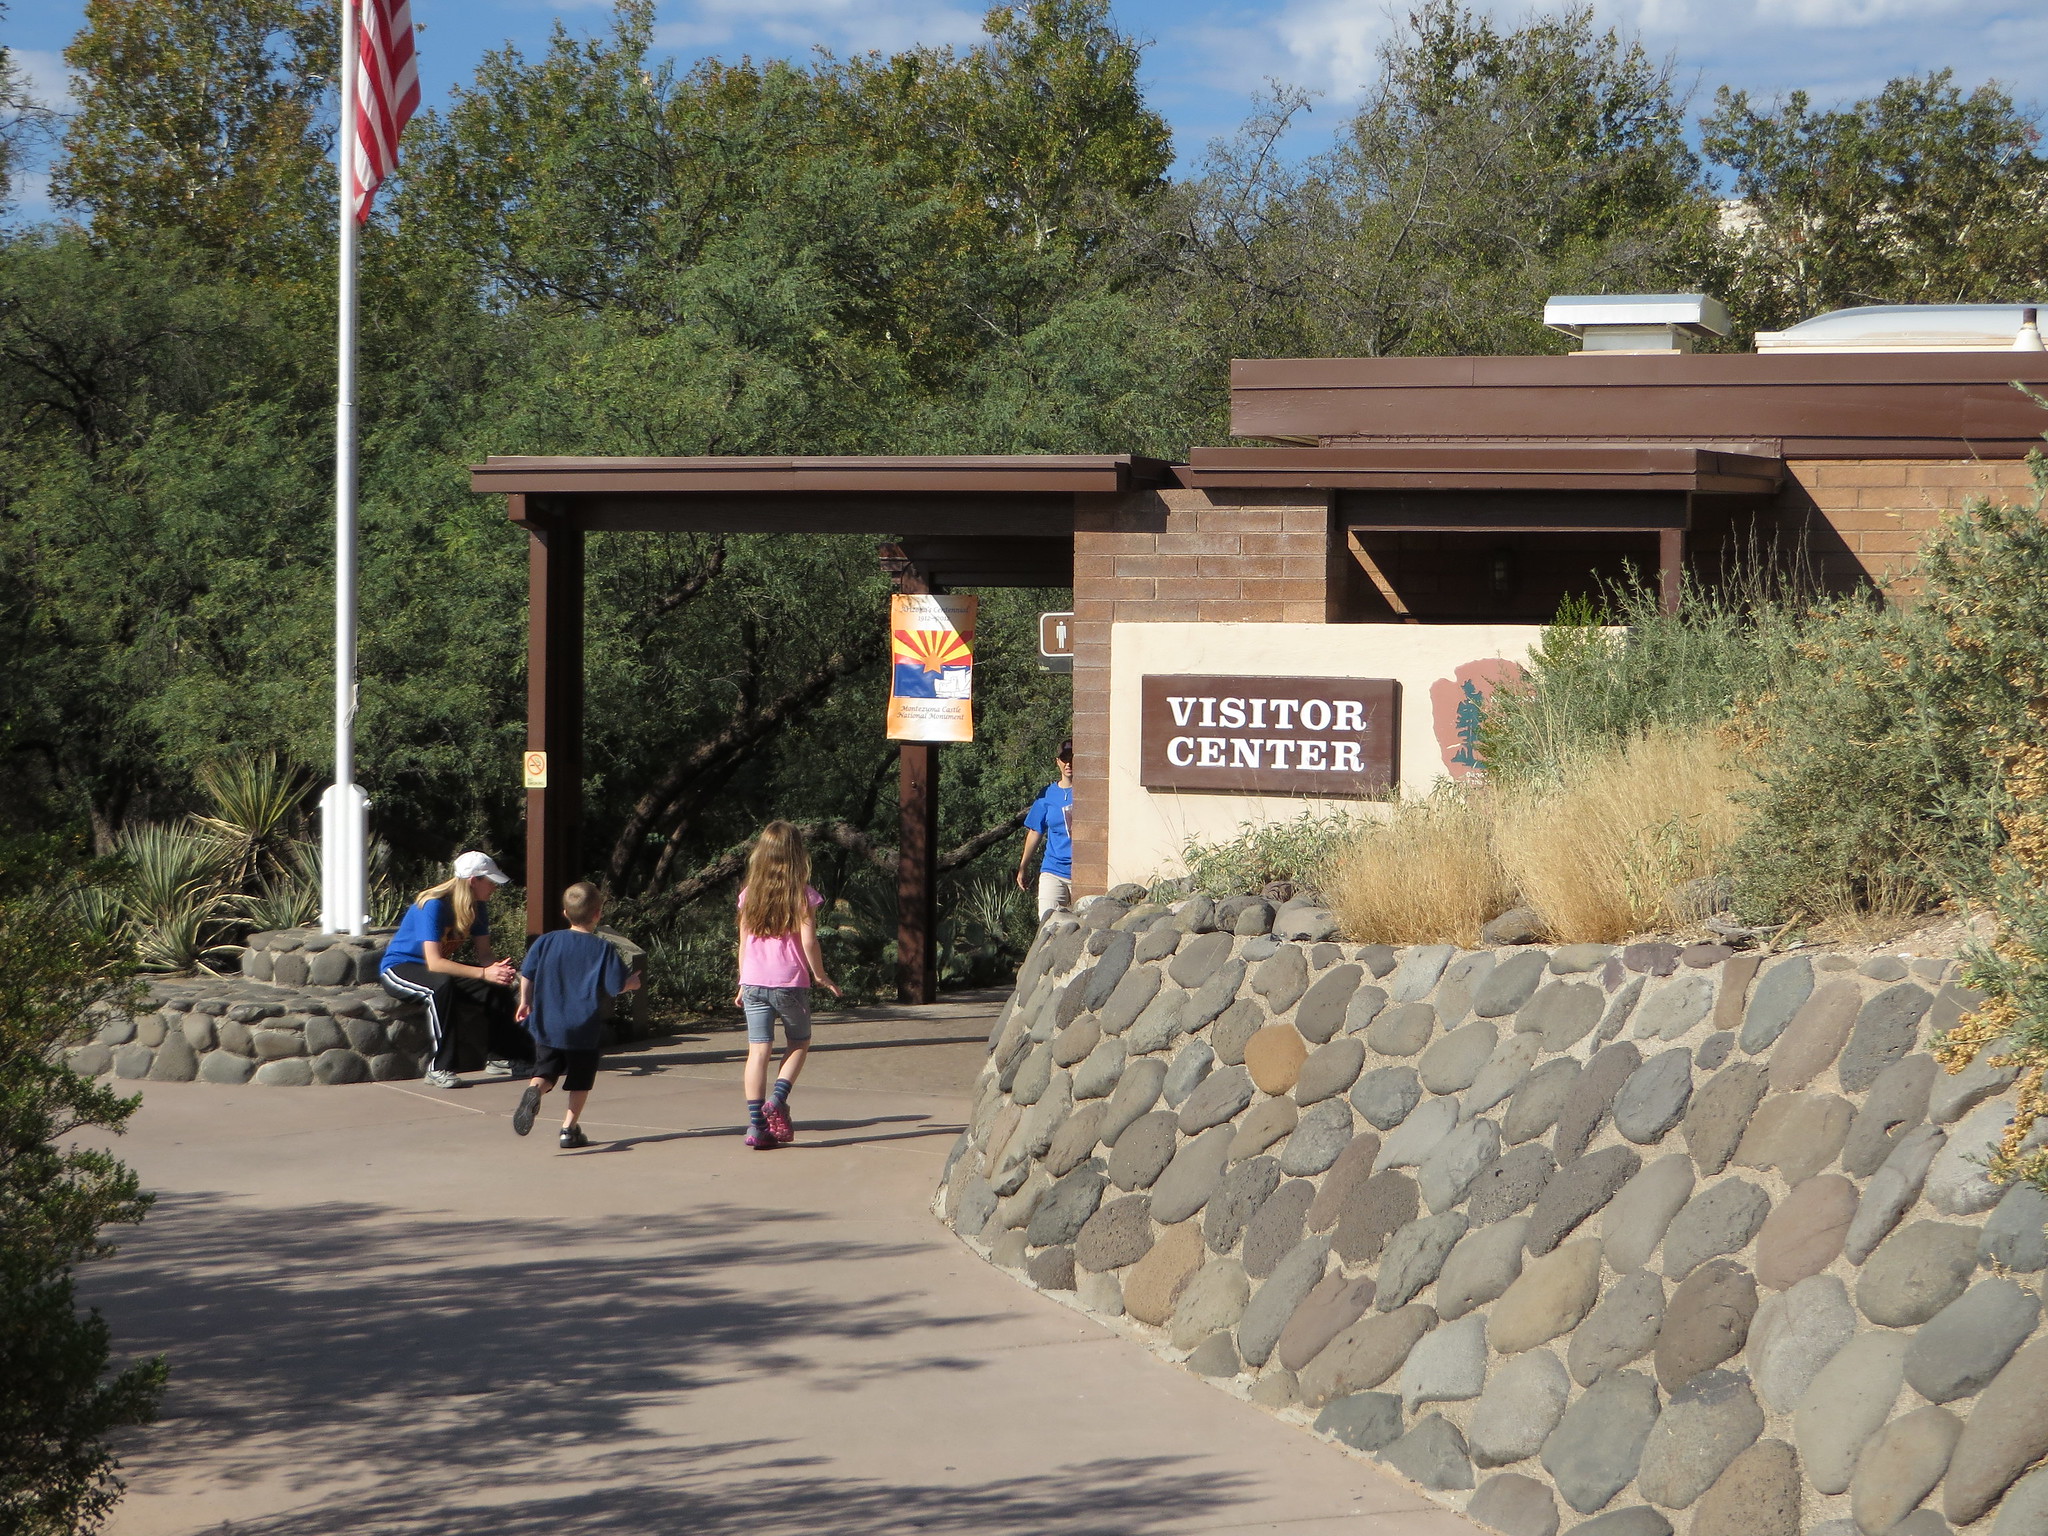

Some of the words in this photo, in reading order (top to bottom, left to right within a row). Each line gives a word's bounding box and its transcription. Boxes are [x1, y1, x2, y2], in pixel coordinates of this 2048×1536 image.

[901, 705, 940, 714] Montezuma
[942, 705, 962, 713] Castle
[1166, 696, 1367, 731] VISITOR
[1166, 736, 1364, 772] CENTER
